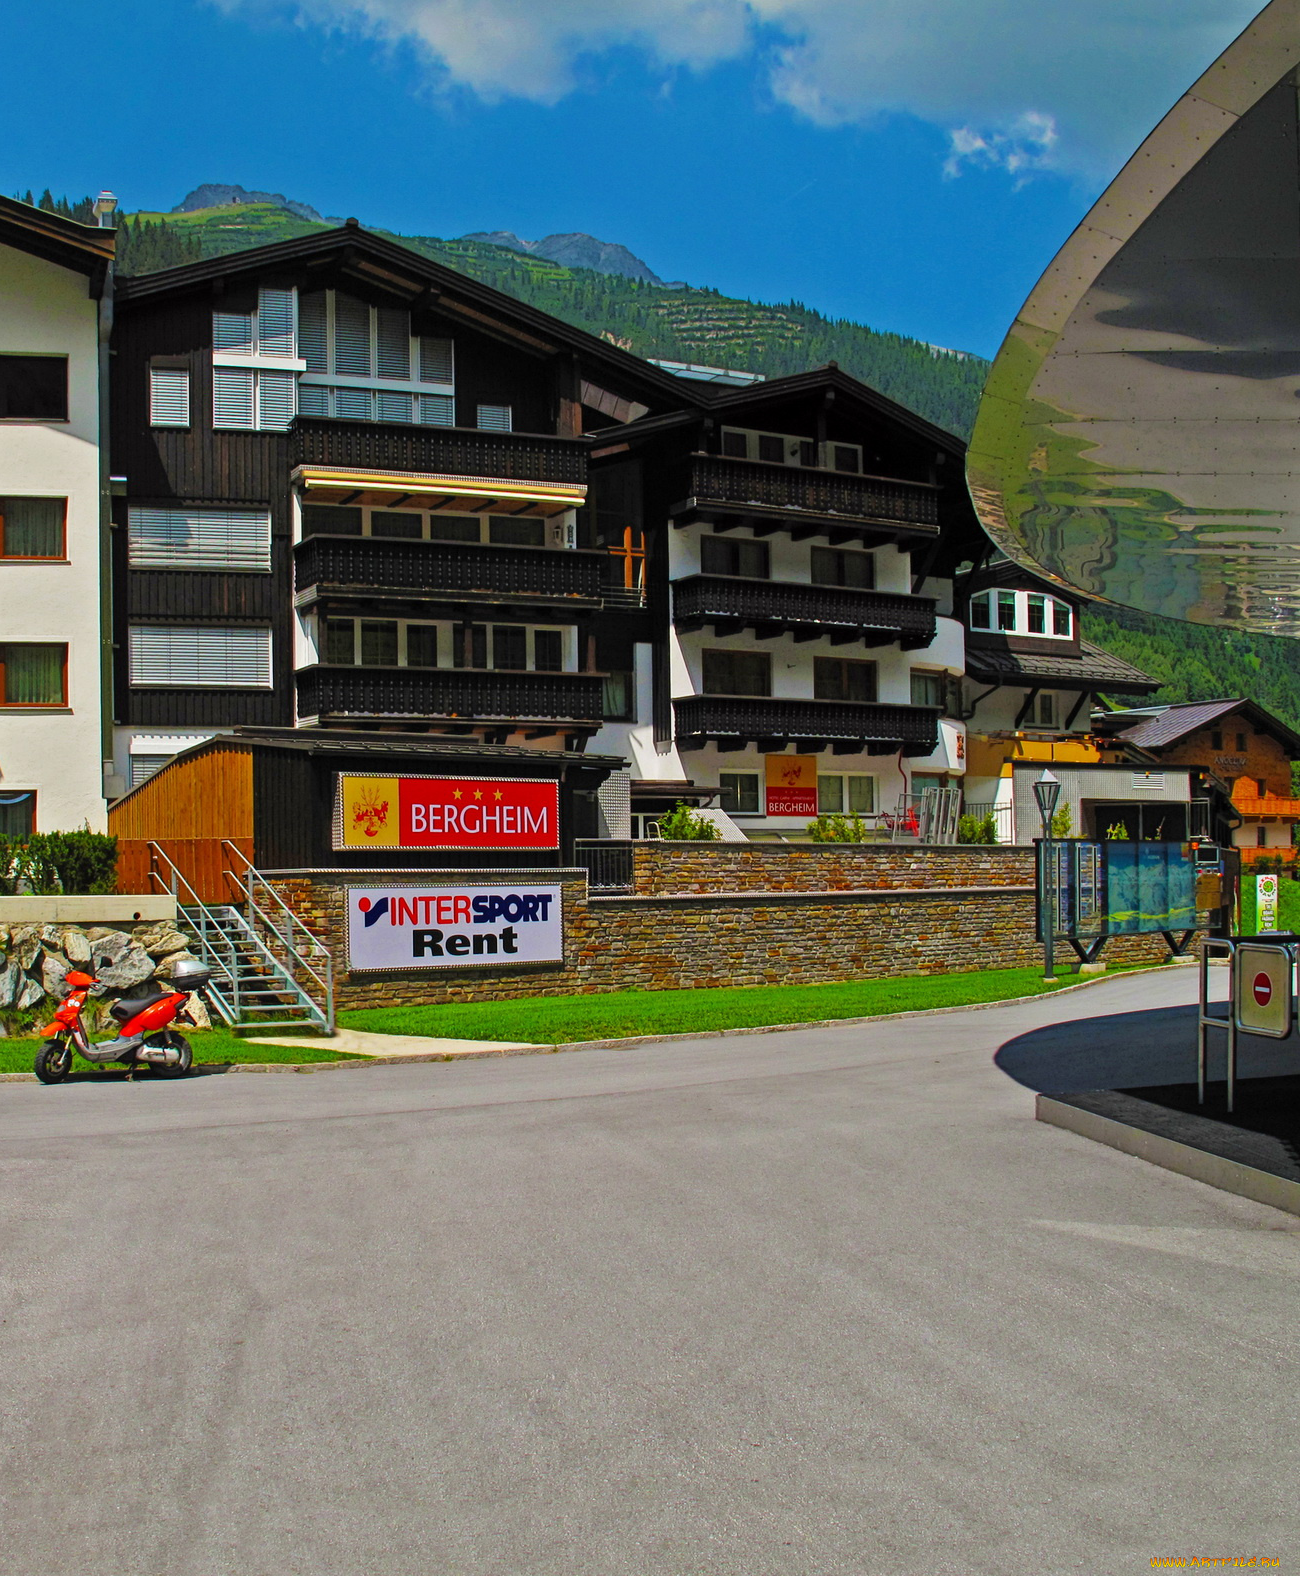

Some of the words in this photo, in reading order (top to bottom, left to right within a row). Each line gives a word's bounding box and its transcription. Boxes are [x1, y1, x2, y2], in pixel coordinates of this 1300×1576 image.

[411, 803, 548, 834] BERGHEIM
[769, 802, 815, 812] BERGHEIM
[390, 893, 553, 926] INTERSPORT
[412, 926, 518, 958] Rent
